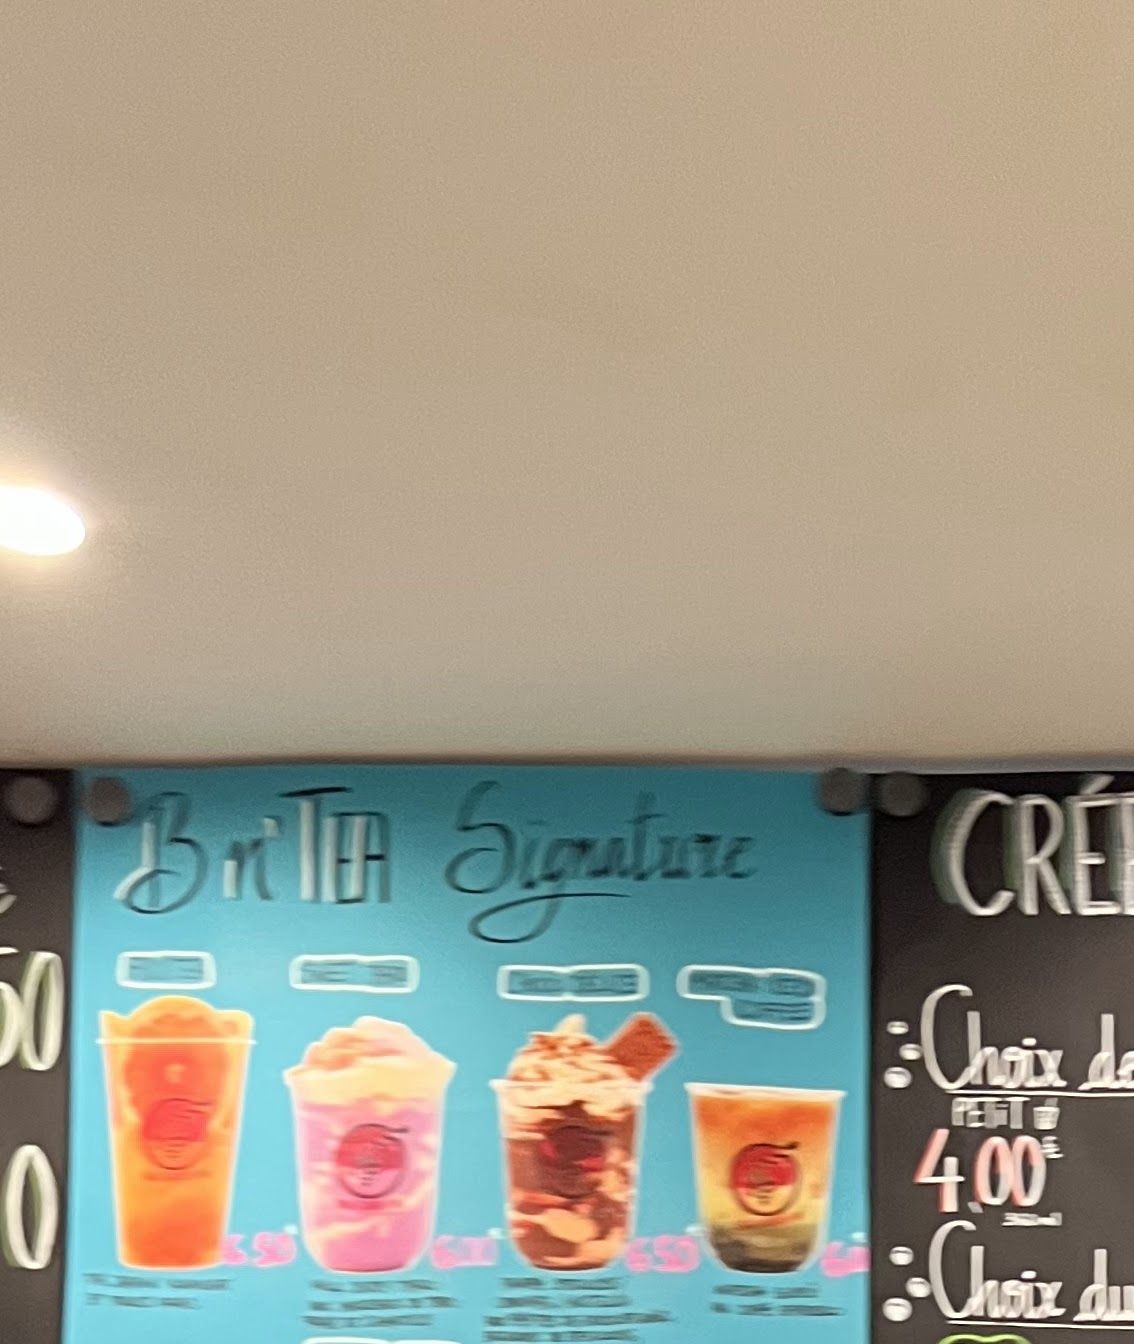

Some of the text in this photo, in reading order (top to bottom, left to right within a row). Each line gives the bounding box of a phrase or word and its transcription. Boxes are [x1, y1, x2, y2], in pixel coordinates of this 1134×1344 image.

[444, 780, 763, 944] Signature
[921, 984, 1067, 1091] Choix
[928, 1220, 1066, 1321] Choix
